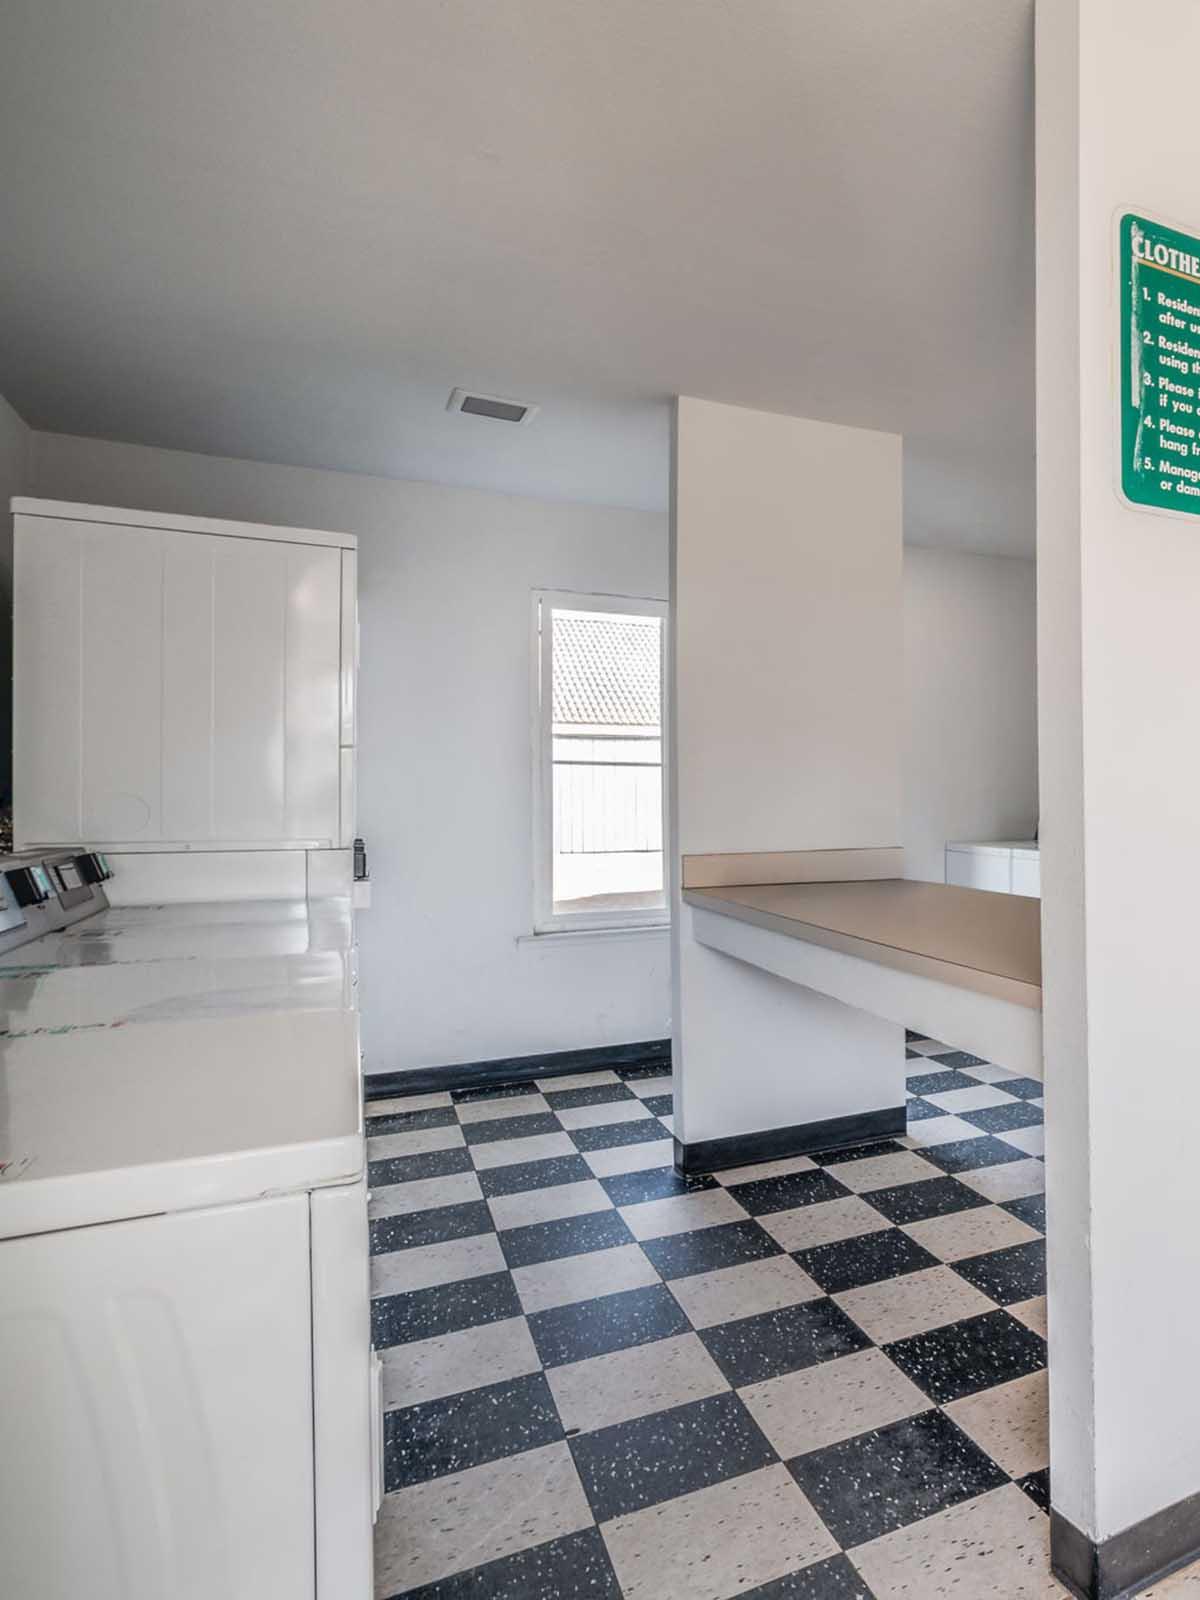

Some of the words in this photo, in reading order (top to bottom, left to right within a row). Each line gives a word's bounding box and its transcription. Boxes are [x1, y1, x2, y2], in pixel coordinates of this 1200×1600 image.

[1143, 288, 1150, 300] 1.
[1159, 312, 1186, 328] after
[1143, 331, 1154, 344] 2.
[1159, 356, 1188, 374] using
[1143, 372, 1154, 386] 3.
[1159, 377, 1194, 396] Please
[1160, 394, 1168, 406] if
[1172, 401, 1192, 413] you
[1144, 416, 1155, 428] 4.
[1160, 419, 1195, 438] Please
[1160, 435, 1188, 456] hang
[1144, 457, 1154, 470] 5.
[1160, 481, 1172, 490] or
